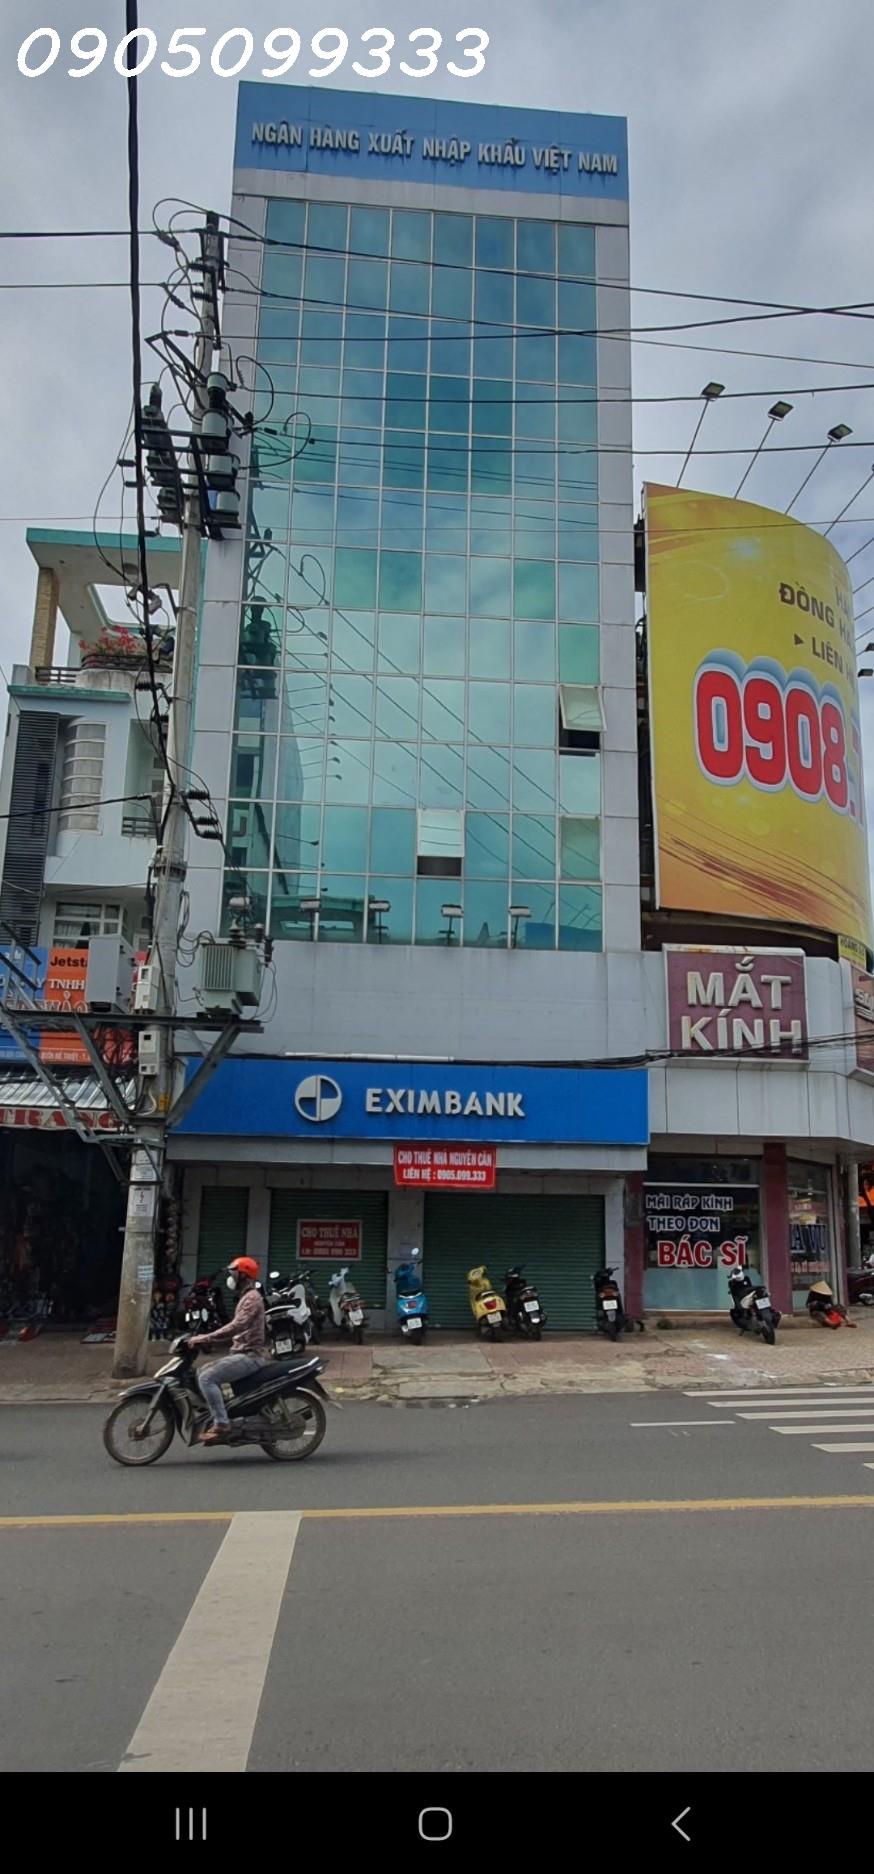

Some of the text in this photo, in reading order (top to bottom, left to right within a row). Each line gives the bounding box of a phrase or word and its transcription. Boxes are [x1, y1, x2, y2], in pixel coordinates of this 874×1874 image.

[251, 120, 618, 176] NGÂN HÀNG XUẤT NHẬP KHẨU VIỆT NAM
[812, 637, 843, 674] LIÊN
[50, 955, 88, 967] Jetst
[49, 979, 85, 989] TNHH
[687, 955, 792, 1010] MẮT
[681, 1008, 802, 1054] KÍNH
[365, 1088, 525, 1117] EXIMBANK
[398, 1150, 412, 1164] CHO
[647, 1215, 685, 1232] THEO
[657, 1234, 748, 1268] BÁC SĨ
